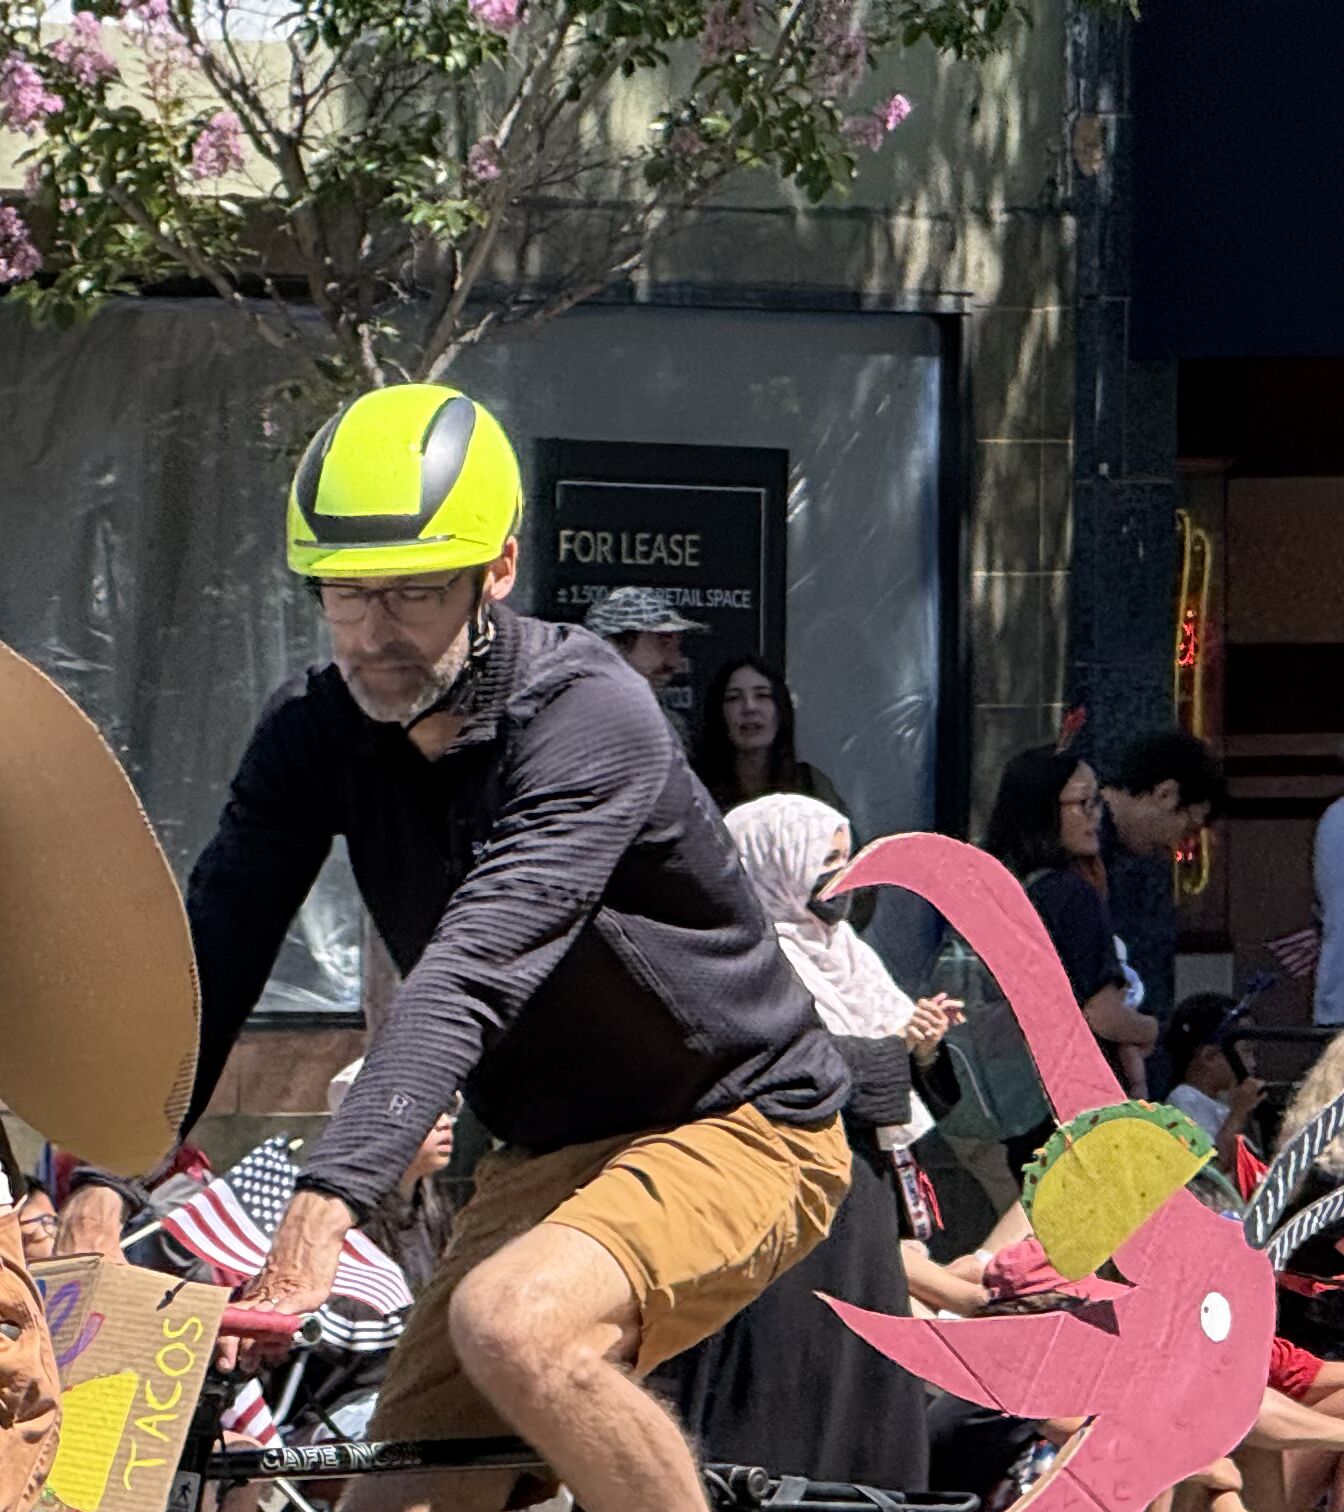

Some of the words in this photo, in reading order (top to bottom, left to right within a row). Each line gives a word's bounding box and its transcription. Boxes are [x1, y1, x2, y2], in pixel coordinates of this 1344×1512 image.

[559, 529, 614, 565] FOR
[620, 532, 702, 567] LEASE
[705, 589, 753, 609] SPACE
[123, 1315, 204, 1491] TACOS
[262, 1443, 338, 1473] CAFE
